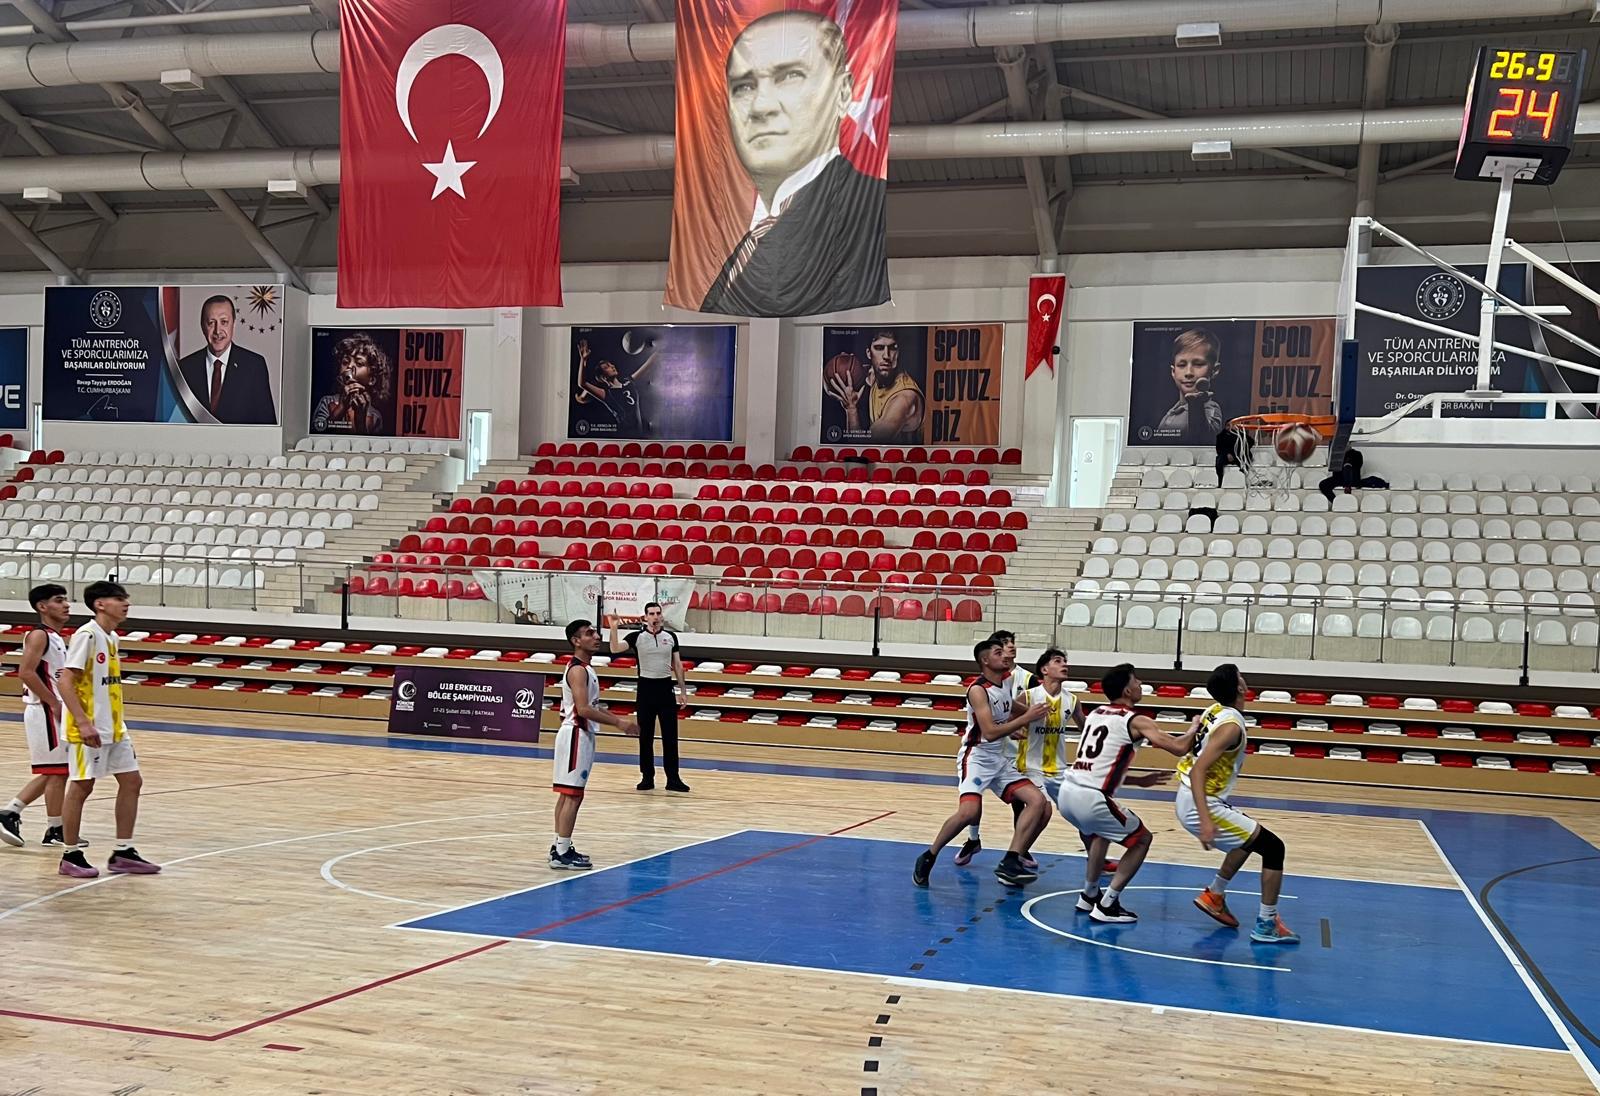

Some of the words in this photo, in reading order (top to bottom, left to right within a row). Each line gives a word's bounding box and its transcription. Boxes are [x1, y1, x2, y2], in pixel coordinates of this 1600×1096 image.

[1490, 51, 1556, 81] 26.9
[1487, 87, 1559, 139] 24
[71, 337, 91, 349] TÜM
[92, 337, 139, 349] ANTRENÖR
[405, 331, 444, 361] SPOR
[935, 328, 981, 361] SPOR
[1262, 325, 1312, 358] SPOR
[1383, 336, 1414, 350] TÜM
[1417, 338, 1480, 350] ANTREN
[61, 349, 73, 359] VE
[74, 349, 149, 360] SPORCULARIMIZA
[1367, 351, 1384, 363] VE
[1387, 351, 1506, 363] SPORCULARIMZA
[64, 361, 104, 371] BAŞARILAR
[104, 360, 147, 370] DİLİYORUM
[1371, 366, 1434, 378] BAŞARILAR
[1436, 364, 1501, 376] DİLİYOM
[1395, 392, 1406, 400] Dr.
[439, 682, 454, 691] U18
[454, 683, 493, 693] ERKEKLER
[427, 690, 452, 700] BÖLGE
[452, 692, 503, 703] ŞAMPİYONASI
[1077, 724, 1109, 759] 13
